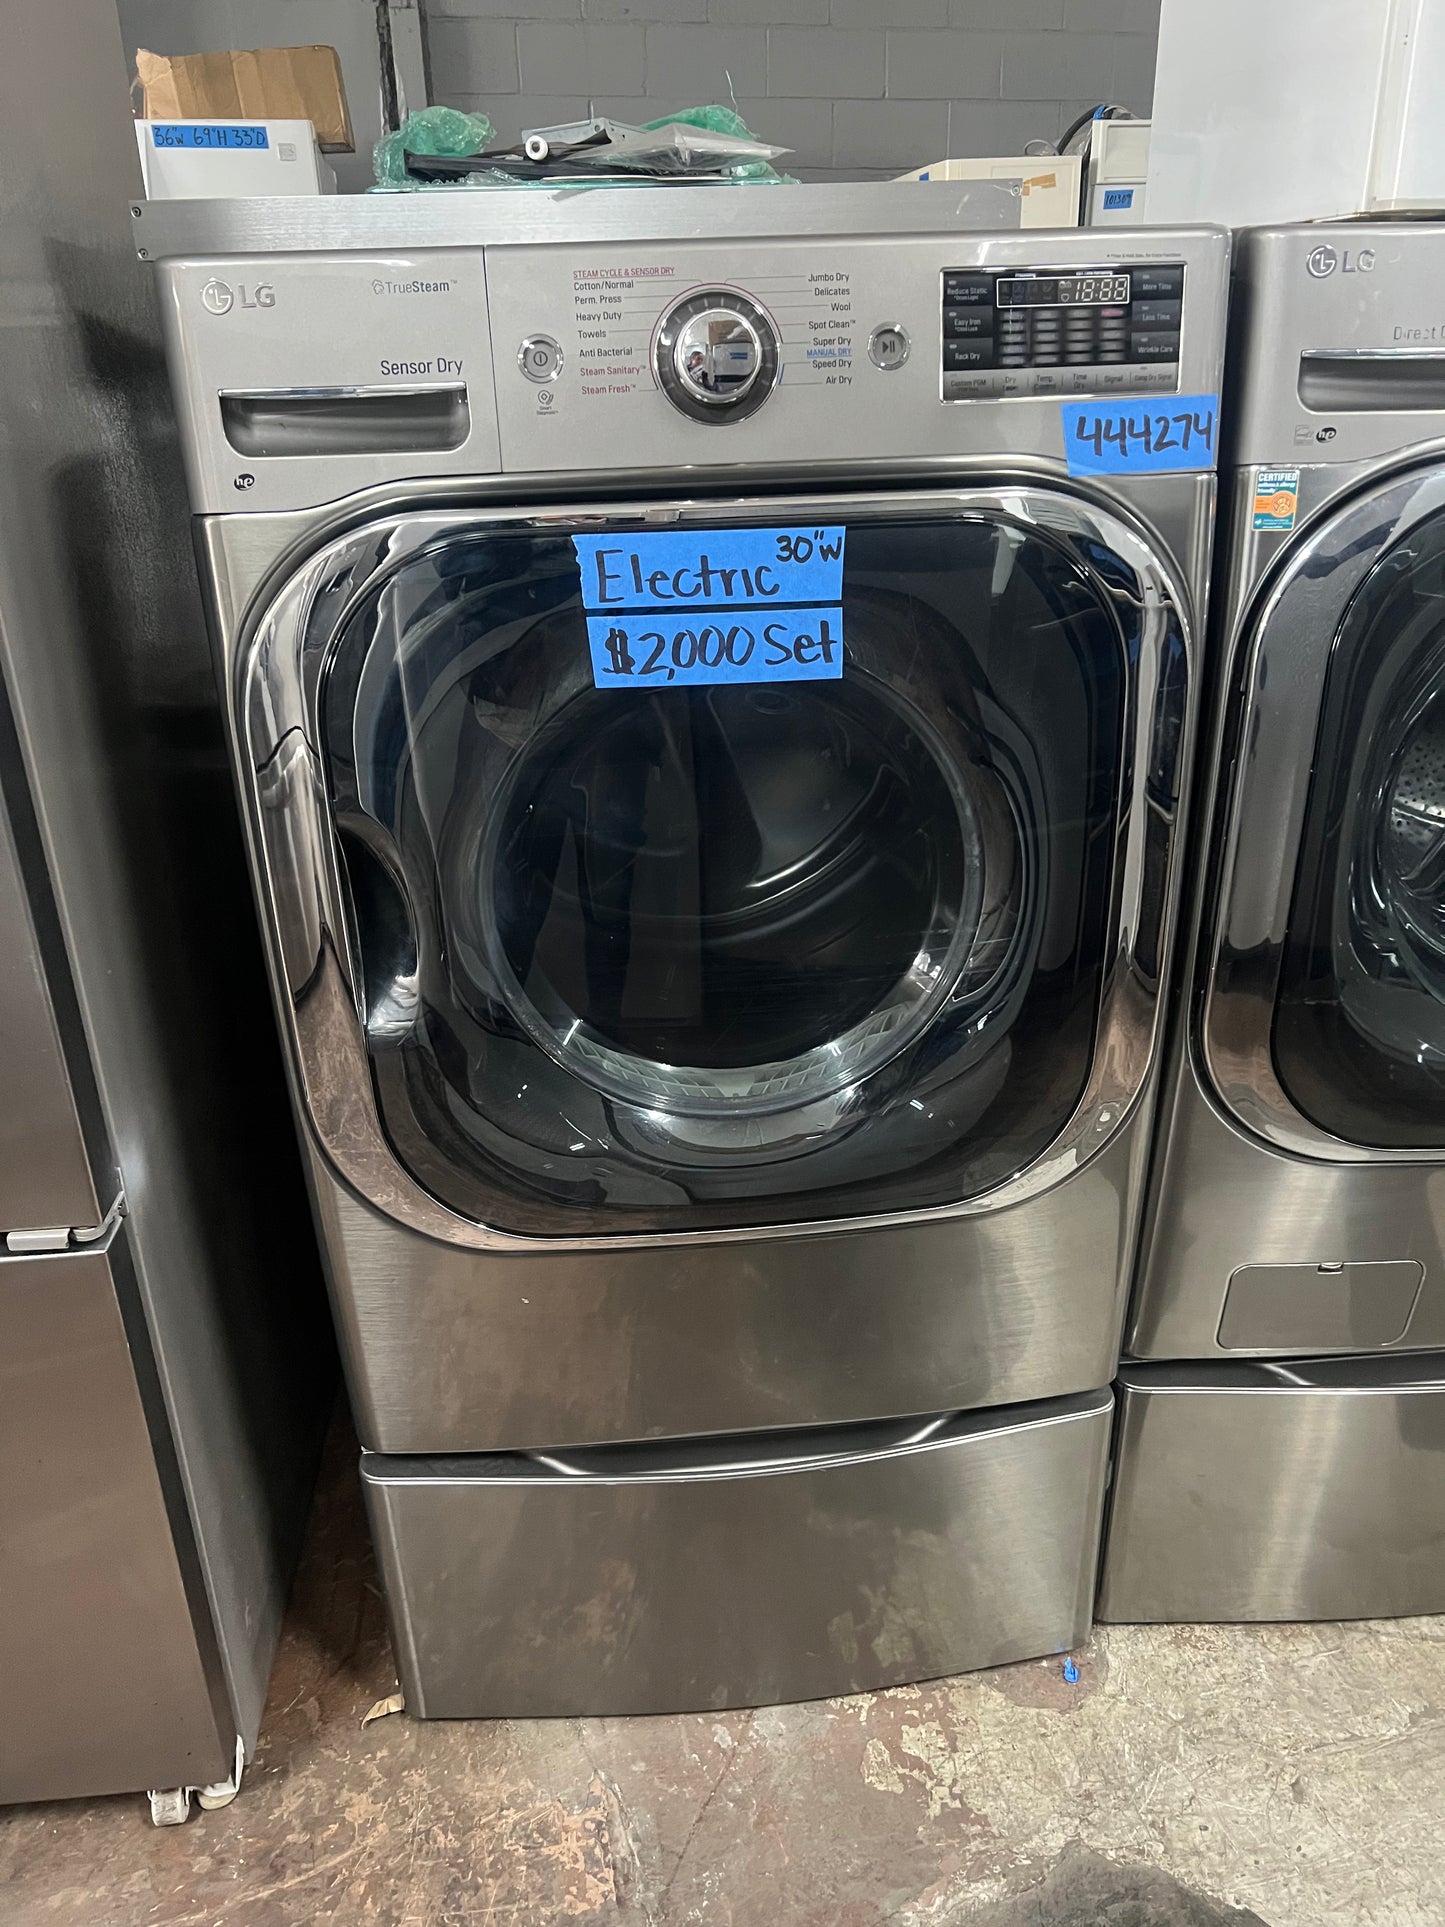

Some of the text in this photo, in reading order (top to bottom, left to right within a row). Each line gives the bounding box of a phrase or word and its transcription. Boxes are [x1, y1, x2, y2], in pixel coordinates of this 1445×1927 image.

[1342, 249, 1376, 273] LG
[573, 266, 675, 278] STEAM CYCLE & SENSOR DRY
[808, 272, 850, 283] Jumbo Dry
[573, 280, 634, 291] Cotton/Normal
[1075, 277, 1128, 301] 18:88
[238, 283, 276, 308] LG
[814, 287, 850, 296] Delicates
[574, 295, 622, 305] Perm. Press
[830, 302, 851, 311] Wool
[576, 311, 622, 322] Heavy Duty
[808, 320, 827, 331] Spot
[578, 329, 607, 339] Towels
[813, 336, 852, 347] Super Dry
[579, 346, 633, 358] Anti Bacterial
[806, 347, 852, 358] MANUAL DRY
[380, 357, 464, 376] Sensor Dry
[812, 358, 852, 370] Speed Dry
[580, 367, 606, 377] Steam
[825, 375, 853, 385] Air Dry
[582, 386, 607, 395] Steam
[1076, 410, 1212, 457] 444274
[1258, 472, 1297, 482] CERTIFIED
[595, 549, 780, 603] Electric
[602, 620, 838, 680] $2,000 Set
